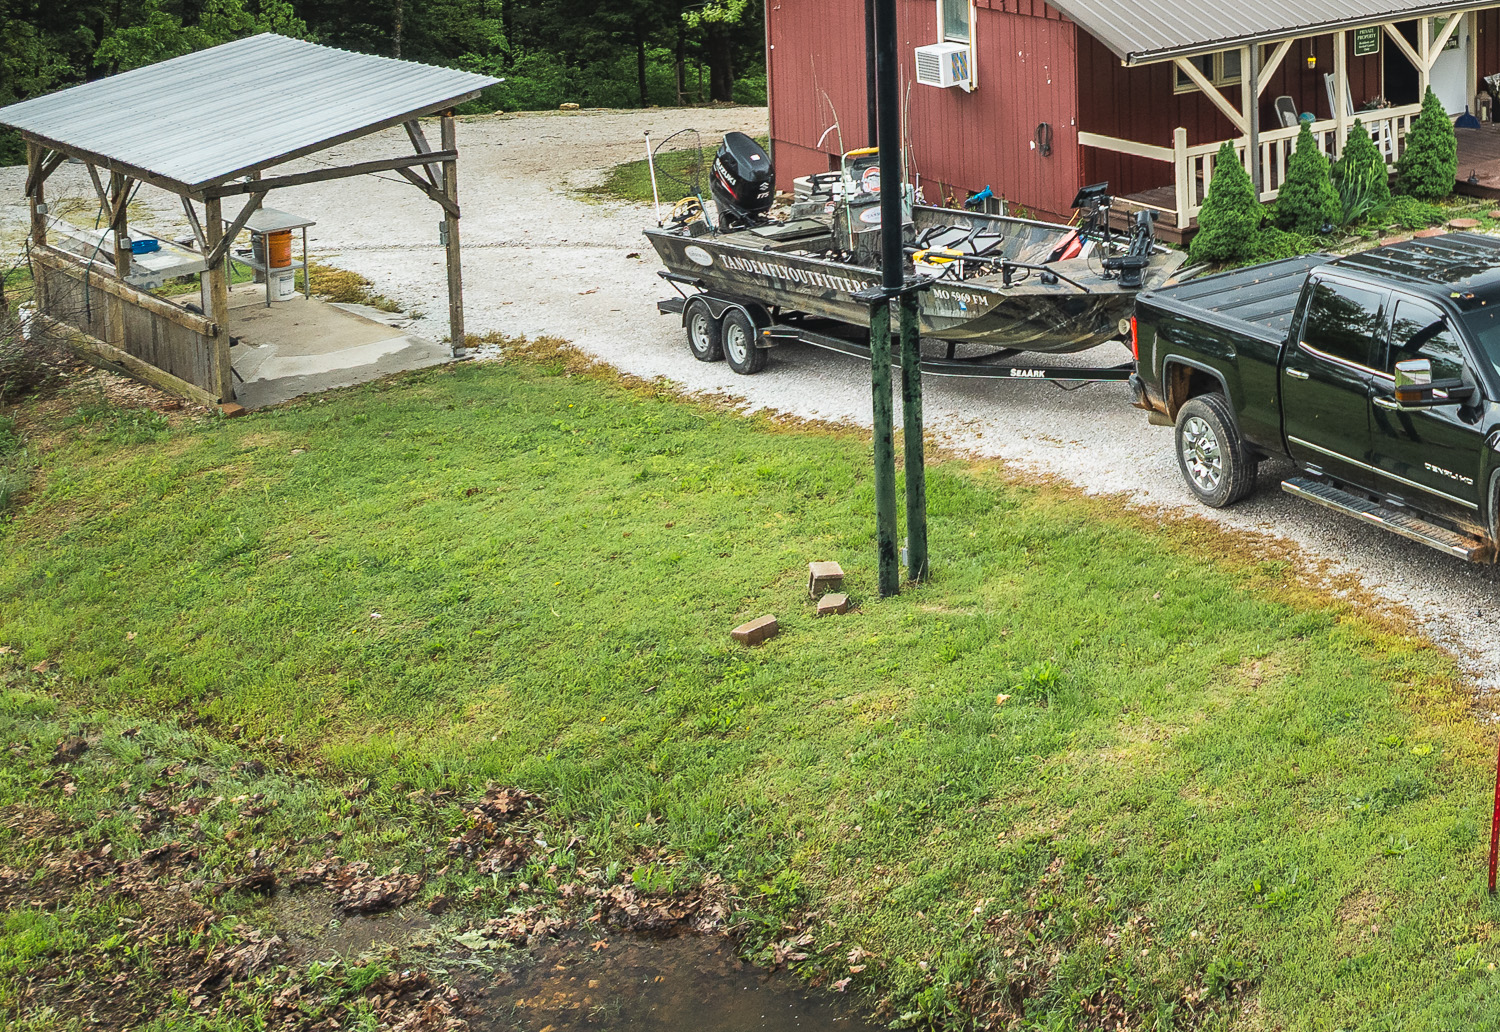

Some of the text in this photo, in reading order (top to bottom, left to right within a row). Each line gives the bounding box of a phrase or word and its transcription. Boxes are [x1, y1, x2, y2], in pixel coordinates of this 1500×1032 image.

[933, 288, 989, 307] MO 5969 FM
